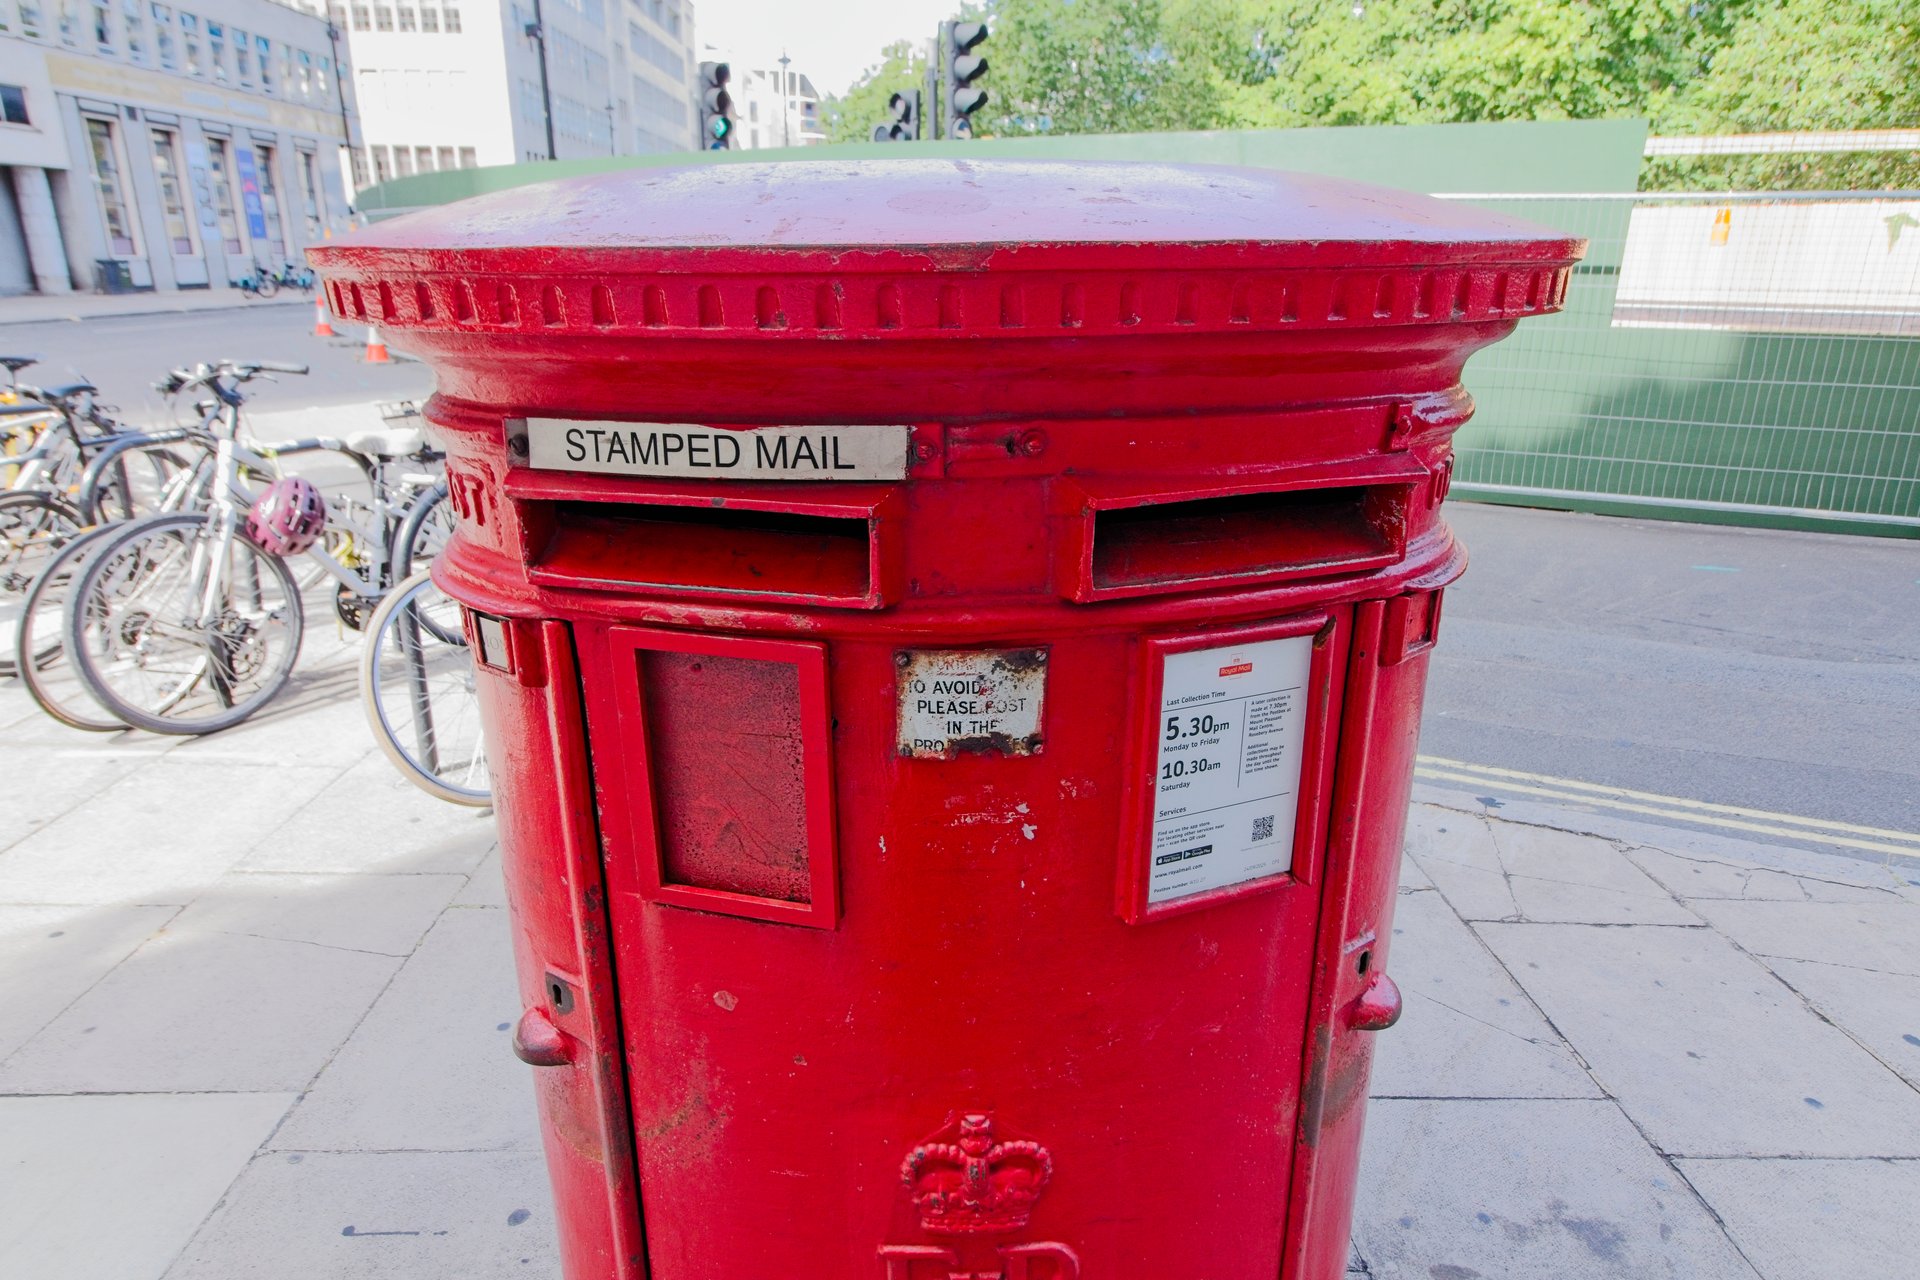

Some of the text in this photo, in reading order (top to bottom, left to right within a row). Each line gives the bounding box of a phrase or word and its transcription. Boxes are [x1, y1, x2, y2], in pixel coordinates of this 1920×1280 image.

[566, 428, 856, 470] STAMPED MAIL
[1220, 664, 1252, 675] Royal Mail
[933, 681, 981, 695] AVOID
[1182, 694, 1210, 704] Collection
[918, 698, 1027, 715] PLEASE POST
[947, 720, 999, 734] IN THE
[1166, 715, 1230, 741] 5.30pm
[1163, 743, 1190, 753] Monday
[1200, 737, 1221, 747] Friday
[1258, 751, 1282, 759] throughout
[1162, 758, 1221, 780] 10.30am
[1160, 781, 1191, 793] Saturday
[1159, 806, 1187, 817] Services
[1165, 833, 1183, 841] locating
[1196, 826, 1214, 834] services
[1154, 863, 1203, 878] www.royalmail.com
[1153, 881, 1188, 893] Postbox number
